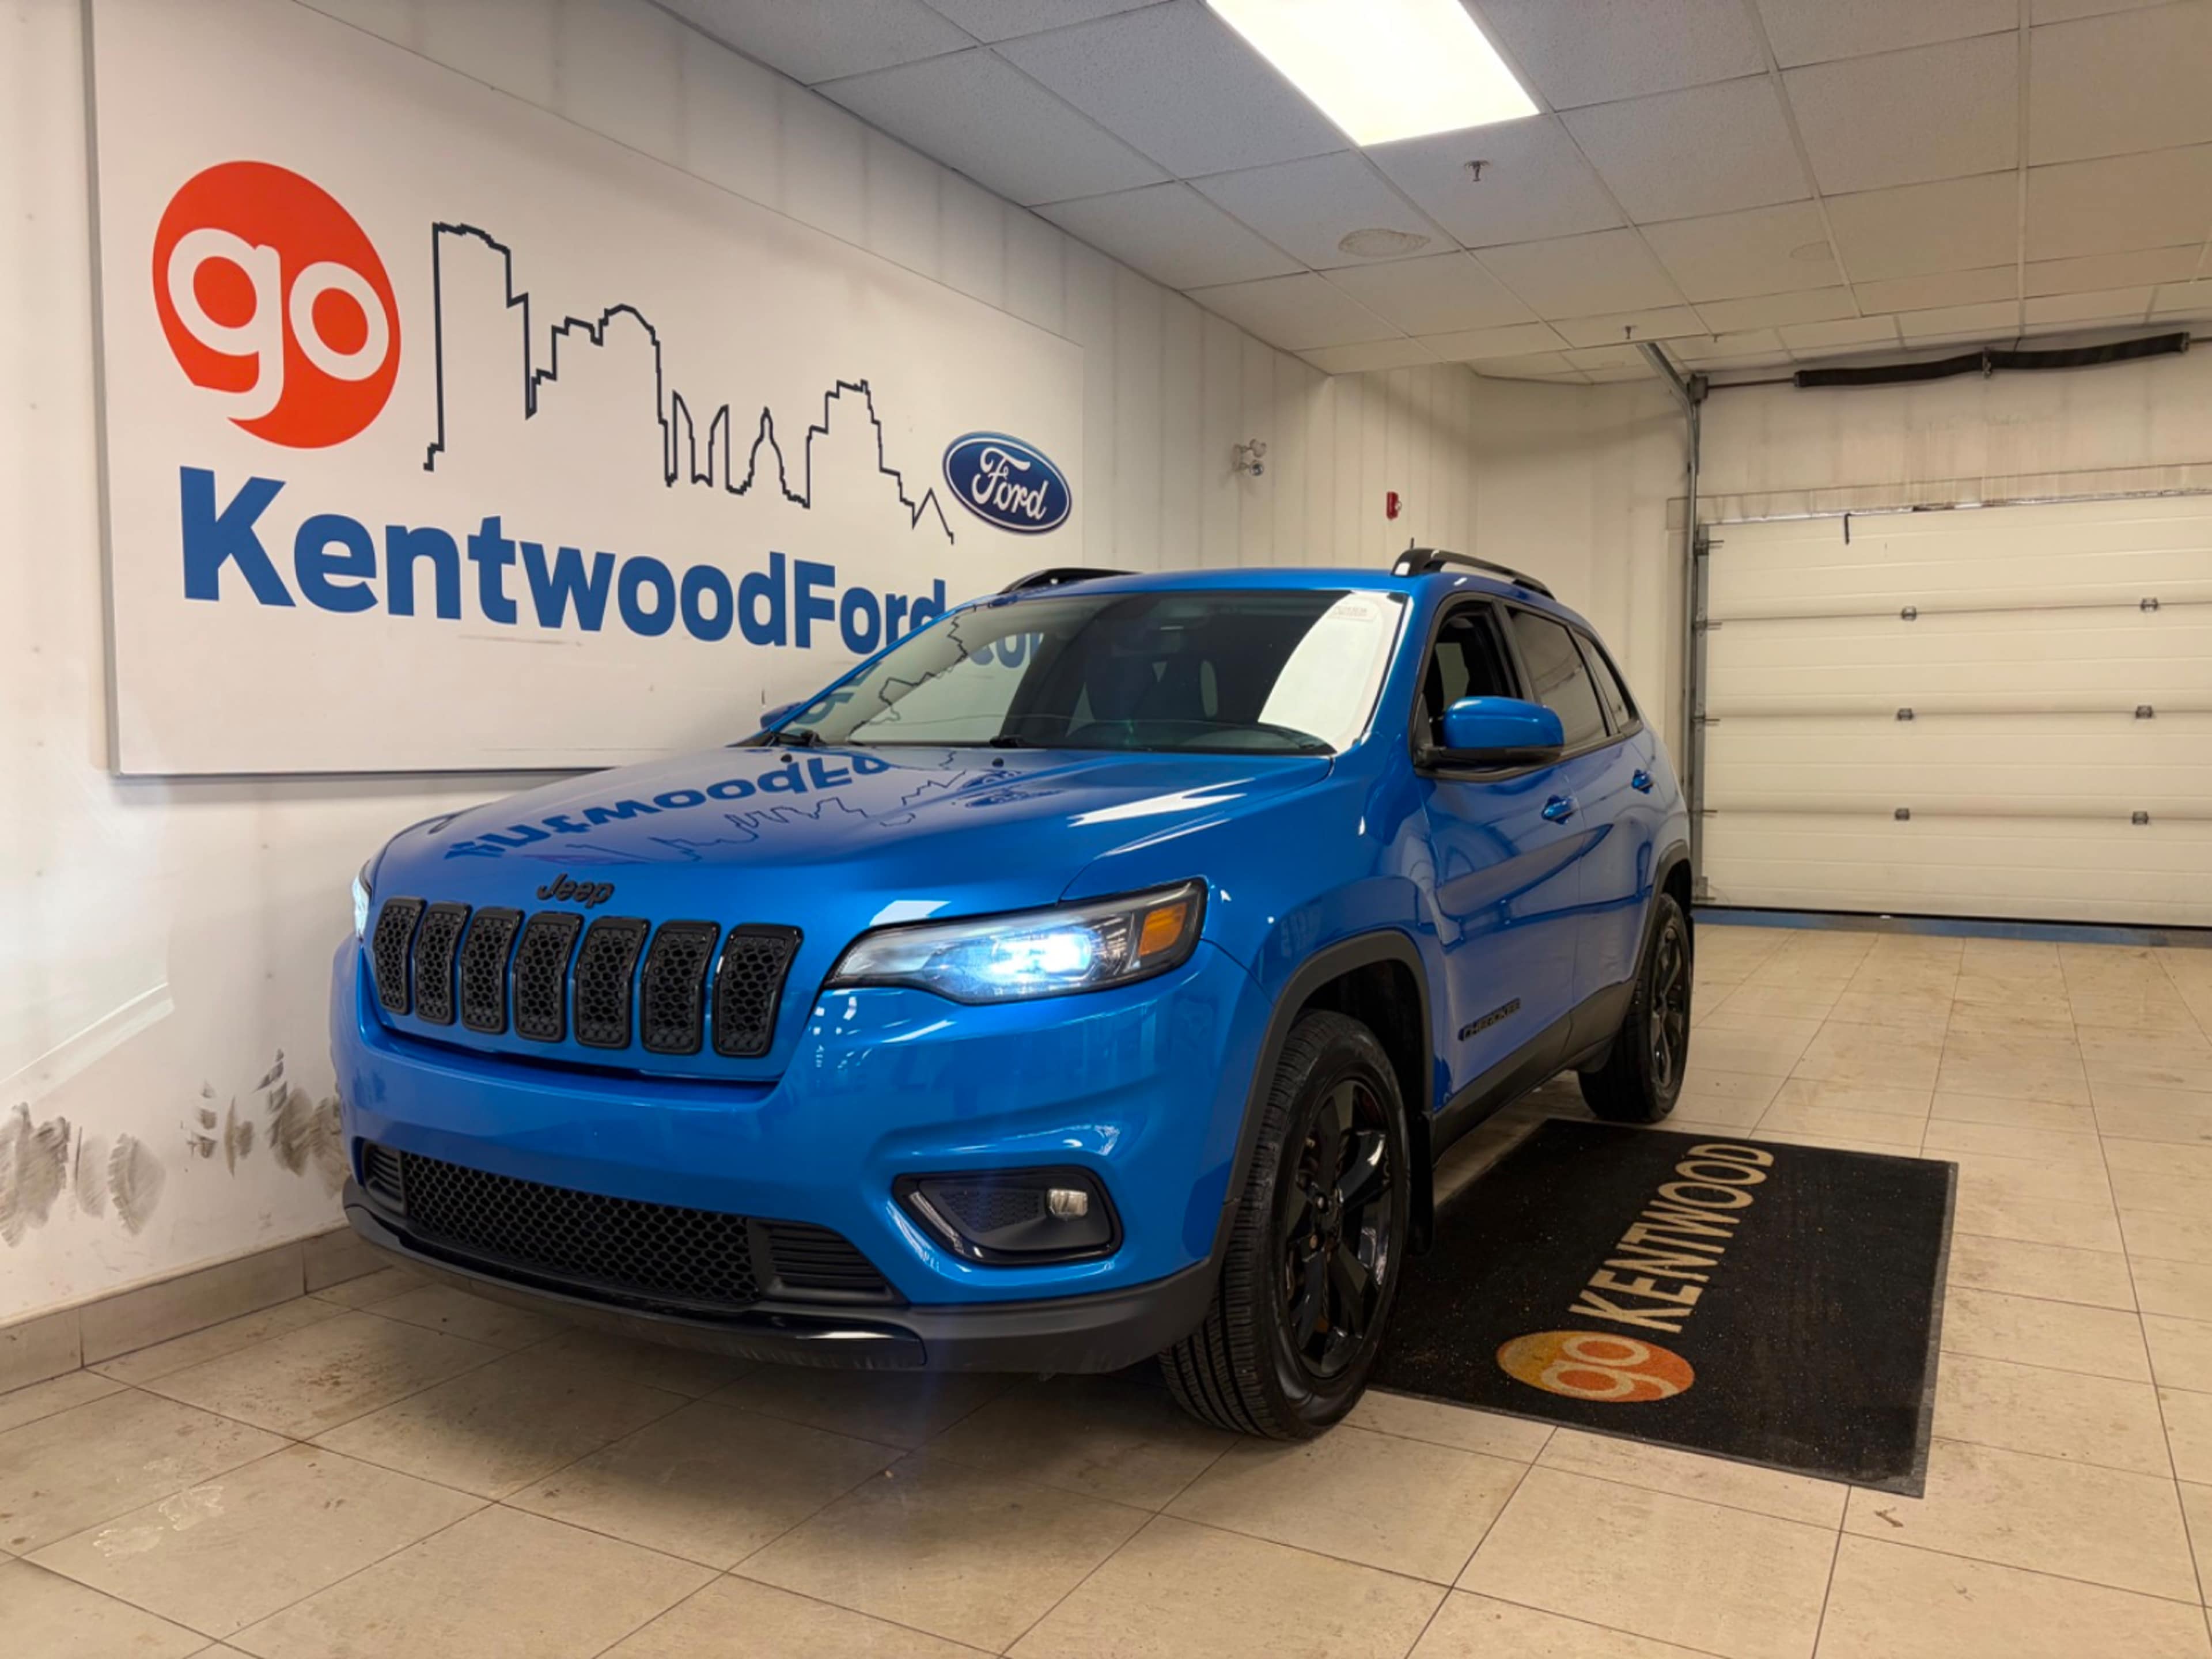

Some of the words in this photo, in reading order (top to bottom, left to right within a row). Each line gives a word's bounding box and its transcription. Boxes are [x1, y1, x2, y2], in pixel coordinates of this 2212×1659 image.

[167, 227, 389, 421] go
[971, 446, 1050, 520] Ford
[536, 872, 615, 910] Jeep
[1567, 1143, 1775, 1334] KENTWOOD
